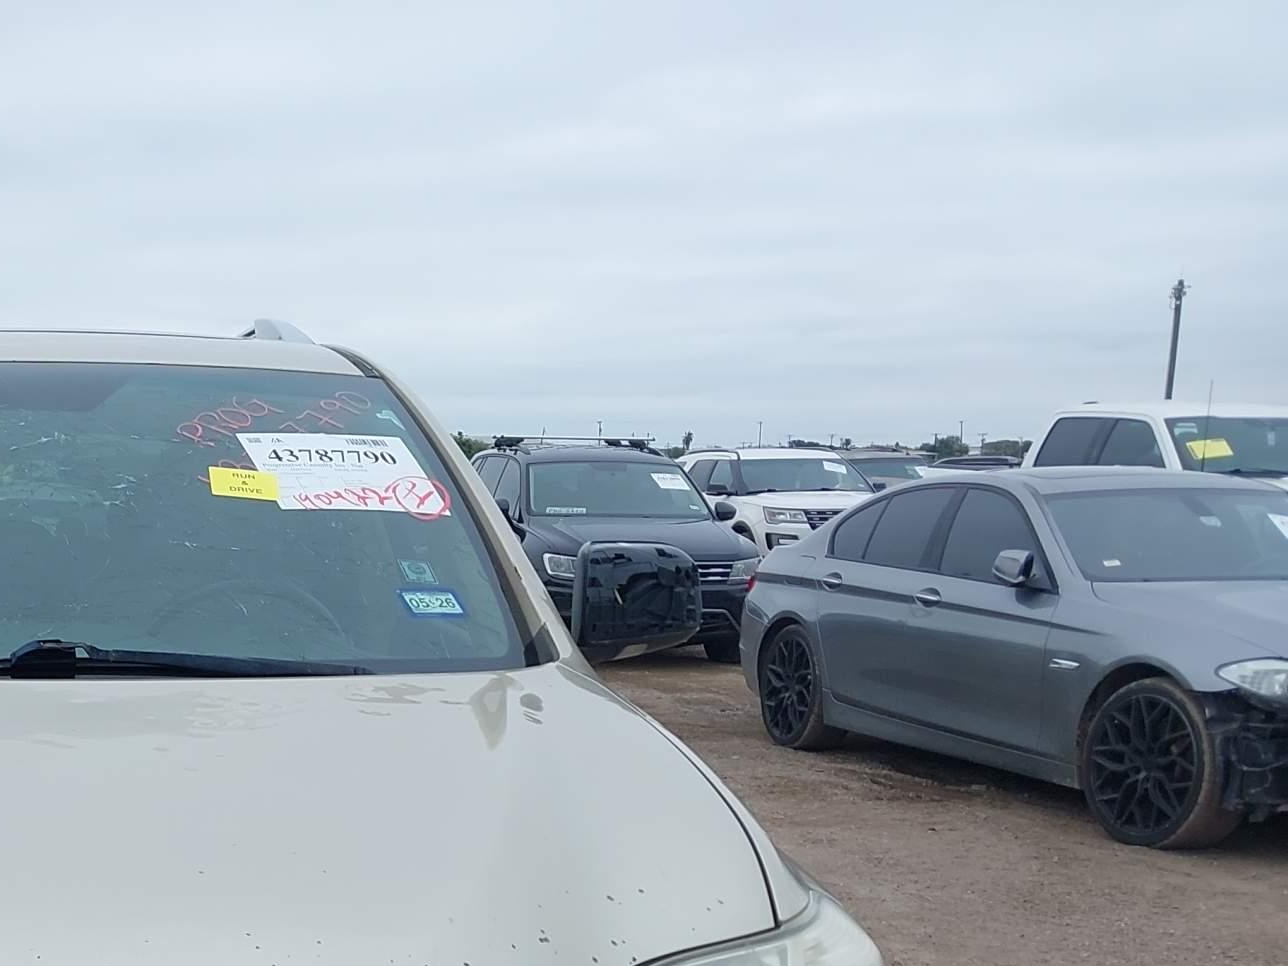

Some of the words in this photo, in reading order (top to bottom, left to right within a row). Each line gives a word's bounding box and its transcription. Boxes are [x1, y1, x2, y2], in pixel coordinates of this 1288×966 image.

[267, 448, 397, 465] 43787790
[232, 472, 256, 480] RUN
[229, 486, 264, 494] DRIVE
